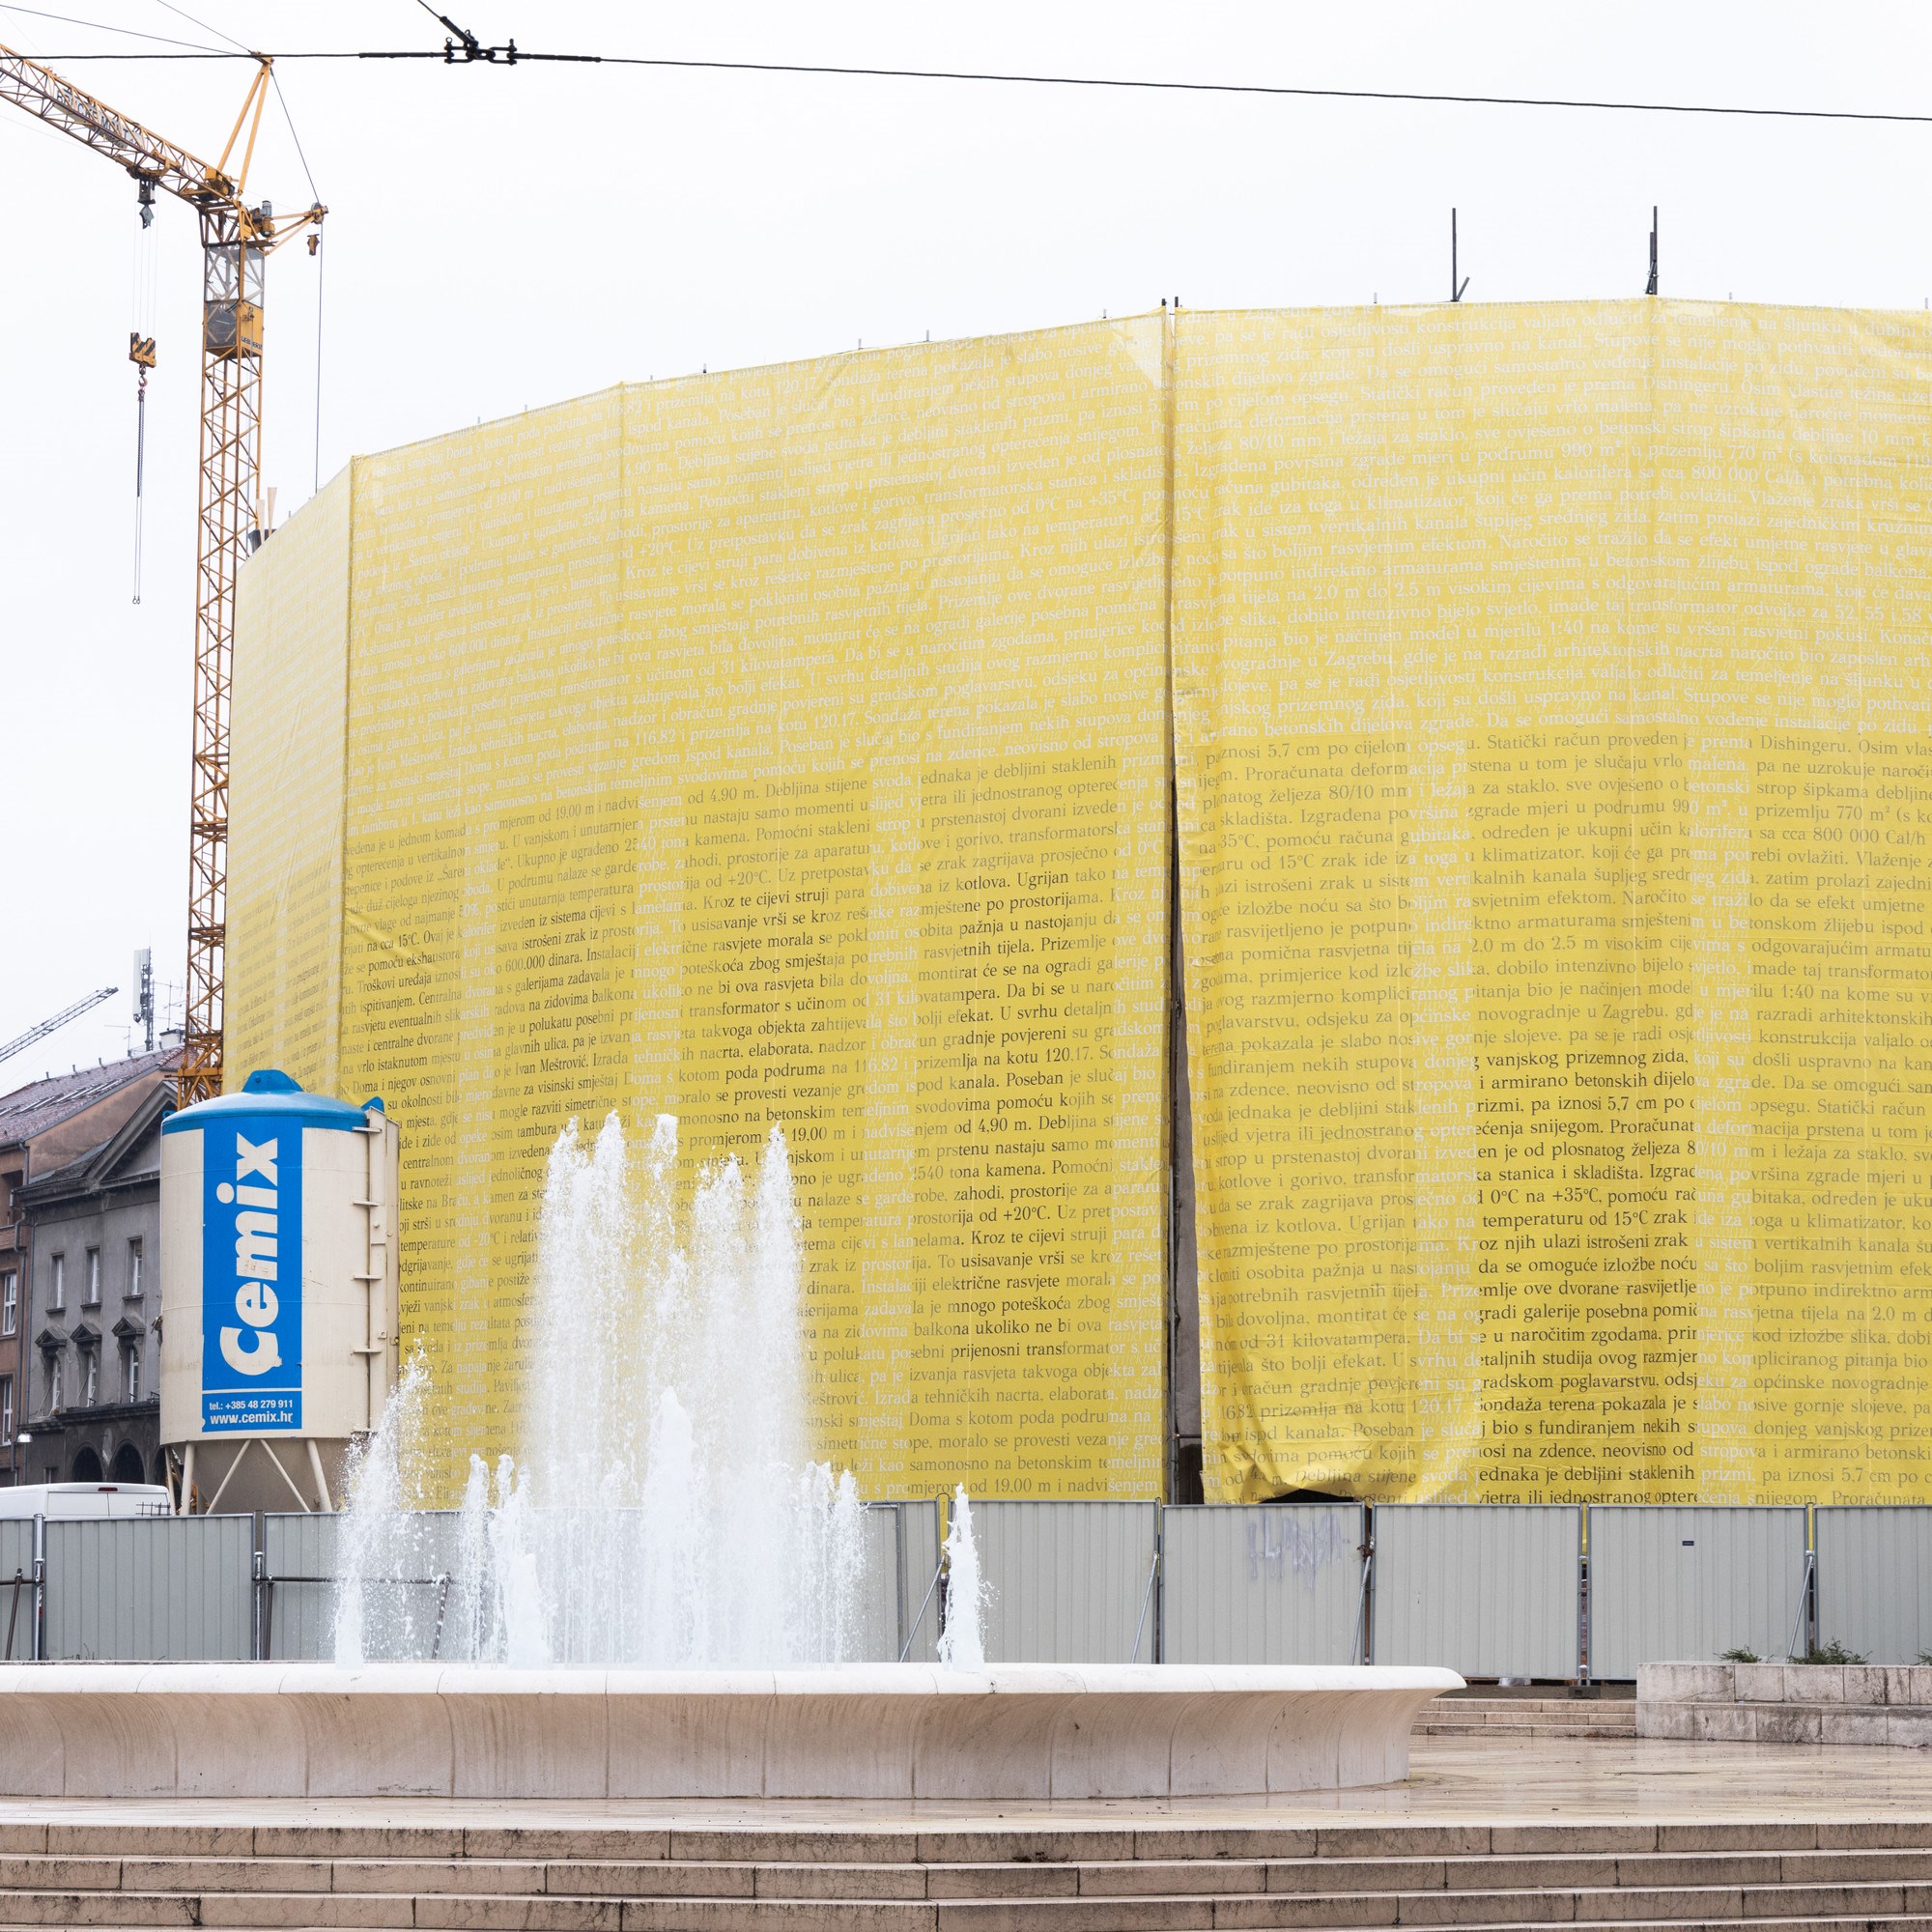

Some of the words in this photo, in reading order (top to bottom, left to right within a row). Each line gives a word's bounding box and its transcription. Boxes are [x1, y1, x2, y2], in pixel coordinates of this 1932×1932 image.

[1859, 740, 1897, 754] Osim
[1804, 782, 1868, 801] šipkama
[1756, 805, 1829, 822] prizemlju
[1837, 806, 1861, 820] 770
[1018, 871, 1068, 890] Ugrijan
[1075, 867, 1105, 882] tako
[987, 900, 1004, 915] po
[960, 920, 1004, 939] pažnja
[1010, 922, 1018, 930] u
[1025, 915, 1095, 931] nastojanju
[1041, 934, 1106, 951] Prizemlje
[1752, 938, 1867, 958] odgovarajućim
[919, 966, 978, 980] montirat
[983, 963, 997, 977] će
[1004, 966, 1016, 976] se
[1023, 964, 1038, 974] na
[1045, 957, 1090, 977] ogradi
[1001, 1007, 1010, 1020] U
[1018, 1005, 1057, 1019] svrhu
[943, 1031, 995, 1050] gradnje
[1001, 1026, 1065, 1047] povjereni
[984, 1056, 1000, 1065] na
[1008, 1051, 1037, 1064] kotu
[1487, 1054, 1558, 1070] vanjskog
[1566, 1054, 1646, 1068] prizemnog
[725, 1065, 757, 1084] poda
[764, 1063, 824, 1082] podruma
[1007, 1071, 1063, 1086] Poseban
[1492, 1077, 1568, 1089] armirano
[1575, 1072, 1647, 1088] betonskih
[1531, 1100, 1549, 1116] pa
[1559, 1096, 1601, 1110] iznosi
[1636, 1099, 1657, 1109] cm
[1664, 1098, 1684, 1113] po
[1818, 1099, 1874, 1114] Statički
[1531, 1120, 1603, 1137] snijegom.
[1505, 1148, 1517, 1162] je
[1524, 1142, 1544, 1156] od
[1552, 1142, 1625, 1161] plosnatog
[1632, 1141, 1680, 1159] željeza
[1499, 1169, 1554, 1180] stanica
[1574, 1165, 1642, 1179] skladišta.
[1010, 1183, 1074, 1203] prostorije
[1526, 1193, 1545, 1203] na
[1608, 1187, 1667, 1208] pomoću
[980, 1208, 997, 1222] od
[1483, 1214, 1582, 1231] temperaturu
[1590, 1211, 1607, 1225] od
[1654, 1209, 1688, 1223] zrak
[972, 1231, 1005, 1244] Kroz
[1011, 1233, 1023, 1243] te
[1029, 1229, 1064, 1246] cijevi
[1506, 1235, 1535, 1254] njih
[1544, 1234, 1579, 1248] ulazi
[1587, 1236, 1648, 1248] istrošeni
[1655, 1233, 1688, 1246] zrak
[1765, 1236, 1851, 1251] vertikalnih
[216, 1131, 282, 1376] Cemix
[961, 1252, 1033, 1269] usisavanje
[1038, 1251, 1065, 1264] vrši
[1479, 1259, 1497, 1273] da
[1506, 1263, 1521, 1272] se
[1529, 1257, 1597, 1276] omoguće
[1604, 1257, 1655, 1271] izložbe
[1661, 1256, 1696, 1269] noću
[1755, 1258, 1803, 1277] boljim
[1812, 1264, 1892, 1278] rasvjetnim
[1007, 1274, 1060, 1292] rasvjete
[1524, 1285, 1551, 1294] ove
[1559, 1280, 1619, 1294] dvorane
[949, 1302, 995, 1317] mnogo
[1002, 1295, 1069, 1316] poteškoća
[1523, 1303, 1579, 1322] galerije
[1586, 1303, 1647, 1322] posebna
[976, 1320, 1029, 1334] ukoliko
[1036, 1323, 1052, 1332] ne
[1494, 1333, 1503, 1342] u
[1511, 1327, 1585, 1341] naročitim
[952, 1343, 1019, 1362] prijenosni
[1543, 1350, 1592, 1369] studija
[1599, 1354, 1636, 1369] ovog
[1832, 1376, 1928, 1395] novogradnje
[209, 1402, 223, 1410] tel.:
[225, 1400, 245, 1409] +385
[248, 1400, 258, 1408] 48
[261, 1400, 275, 1408] 279
[278, 1399, 293, 1408] 911
[1549, 1400, 1595, 1410] terena
[1603, 1395, 1665, 1415] pokazala
[1673, 1396, 1686, 1413] je
[211, 1410, 293, 1425] www.cemix.hr
[1493, 1420, 1518, 1435] bio
[1525, 1425, 1532, 1435] s
[1539, 1420, 1634, 1438] fundiranjem
[1643, 1418, 1680, 1433] nekih
[1754, 1420, 1807, 1440] donjeg
[1513, 1448, 1531, 1458] na
[1603, 1442, 1665, 1457] neovisno
[1673, 1441, 1693, 1456] od
[910, 1461, 988, 1471] samonosno
[995, 1460, 1011, 1469] na
[1018, 1455, 1092, 1469] betonskim
[1546, 1467, 1558, 1486] je
[1565, 1466, 1622, 1485] debljini
[1630, 1464, 1694, 1480] staklenih
